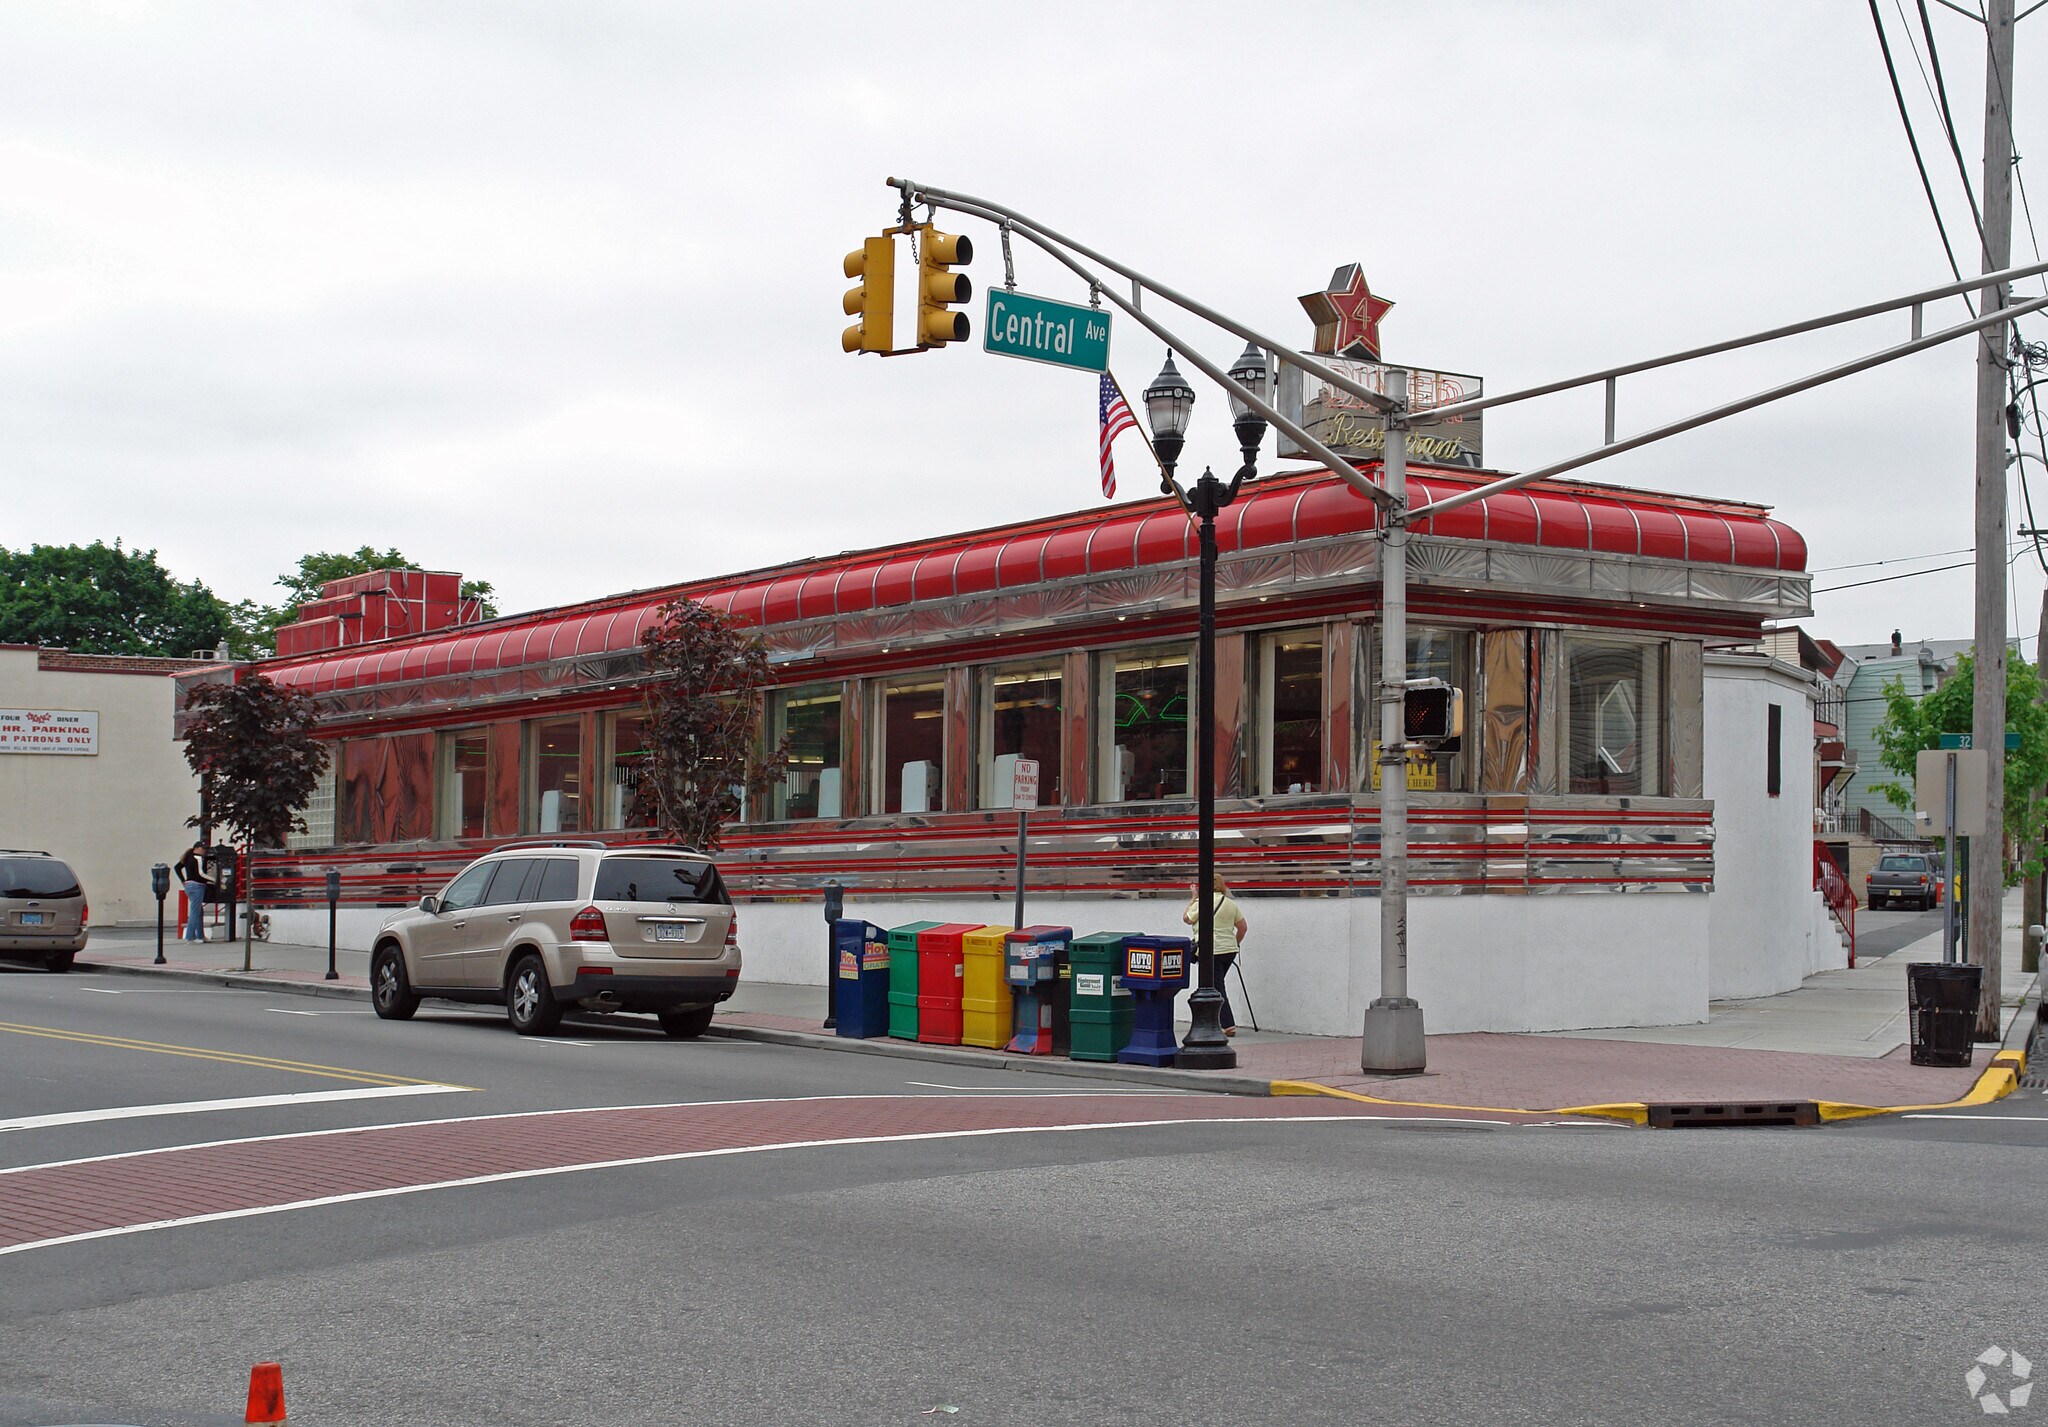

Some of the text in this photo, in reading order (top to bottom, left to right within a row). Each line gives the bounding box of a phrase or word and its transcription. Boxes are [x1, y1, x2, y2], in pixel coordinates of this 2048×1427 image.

[1352, 297, 1372, 330] 4
[992, 302, 1106, 354] Central Ave
[1327, 365, 1464, 424] DIER
[32, 726, 89, 734] PARKING
[1959, 736, 1971, 748] 32
[1021, 764, 1031, 773] NO
[1015, 775, 1037, 785] PARKING
[865, 942, 889, 957] Hoy
[841, 951, 857, 965] Hoy
[1131, 953, 1152, 965] AUTO
[1162, 955, 1181, 966] AUTO
